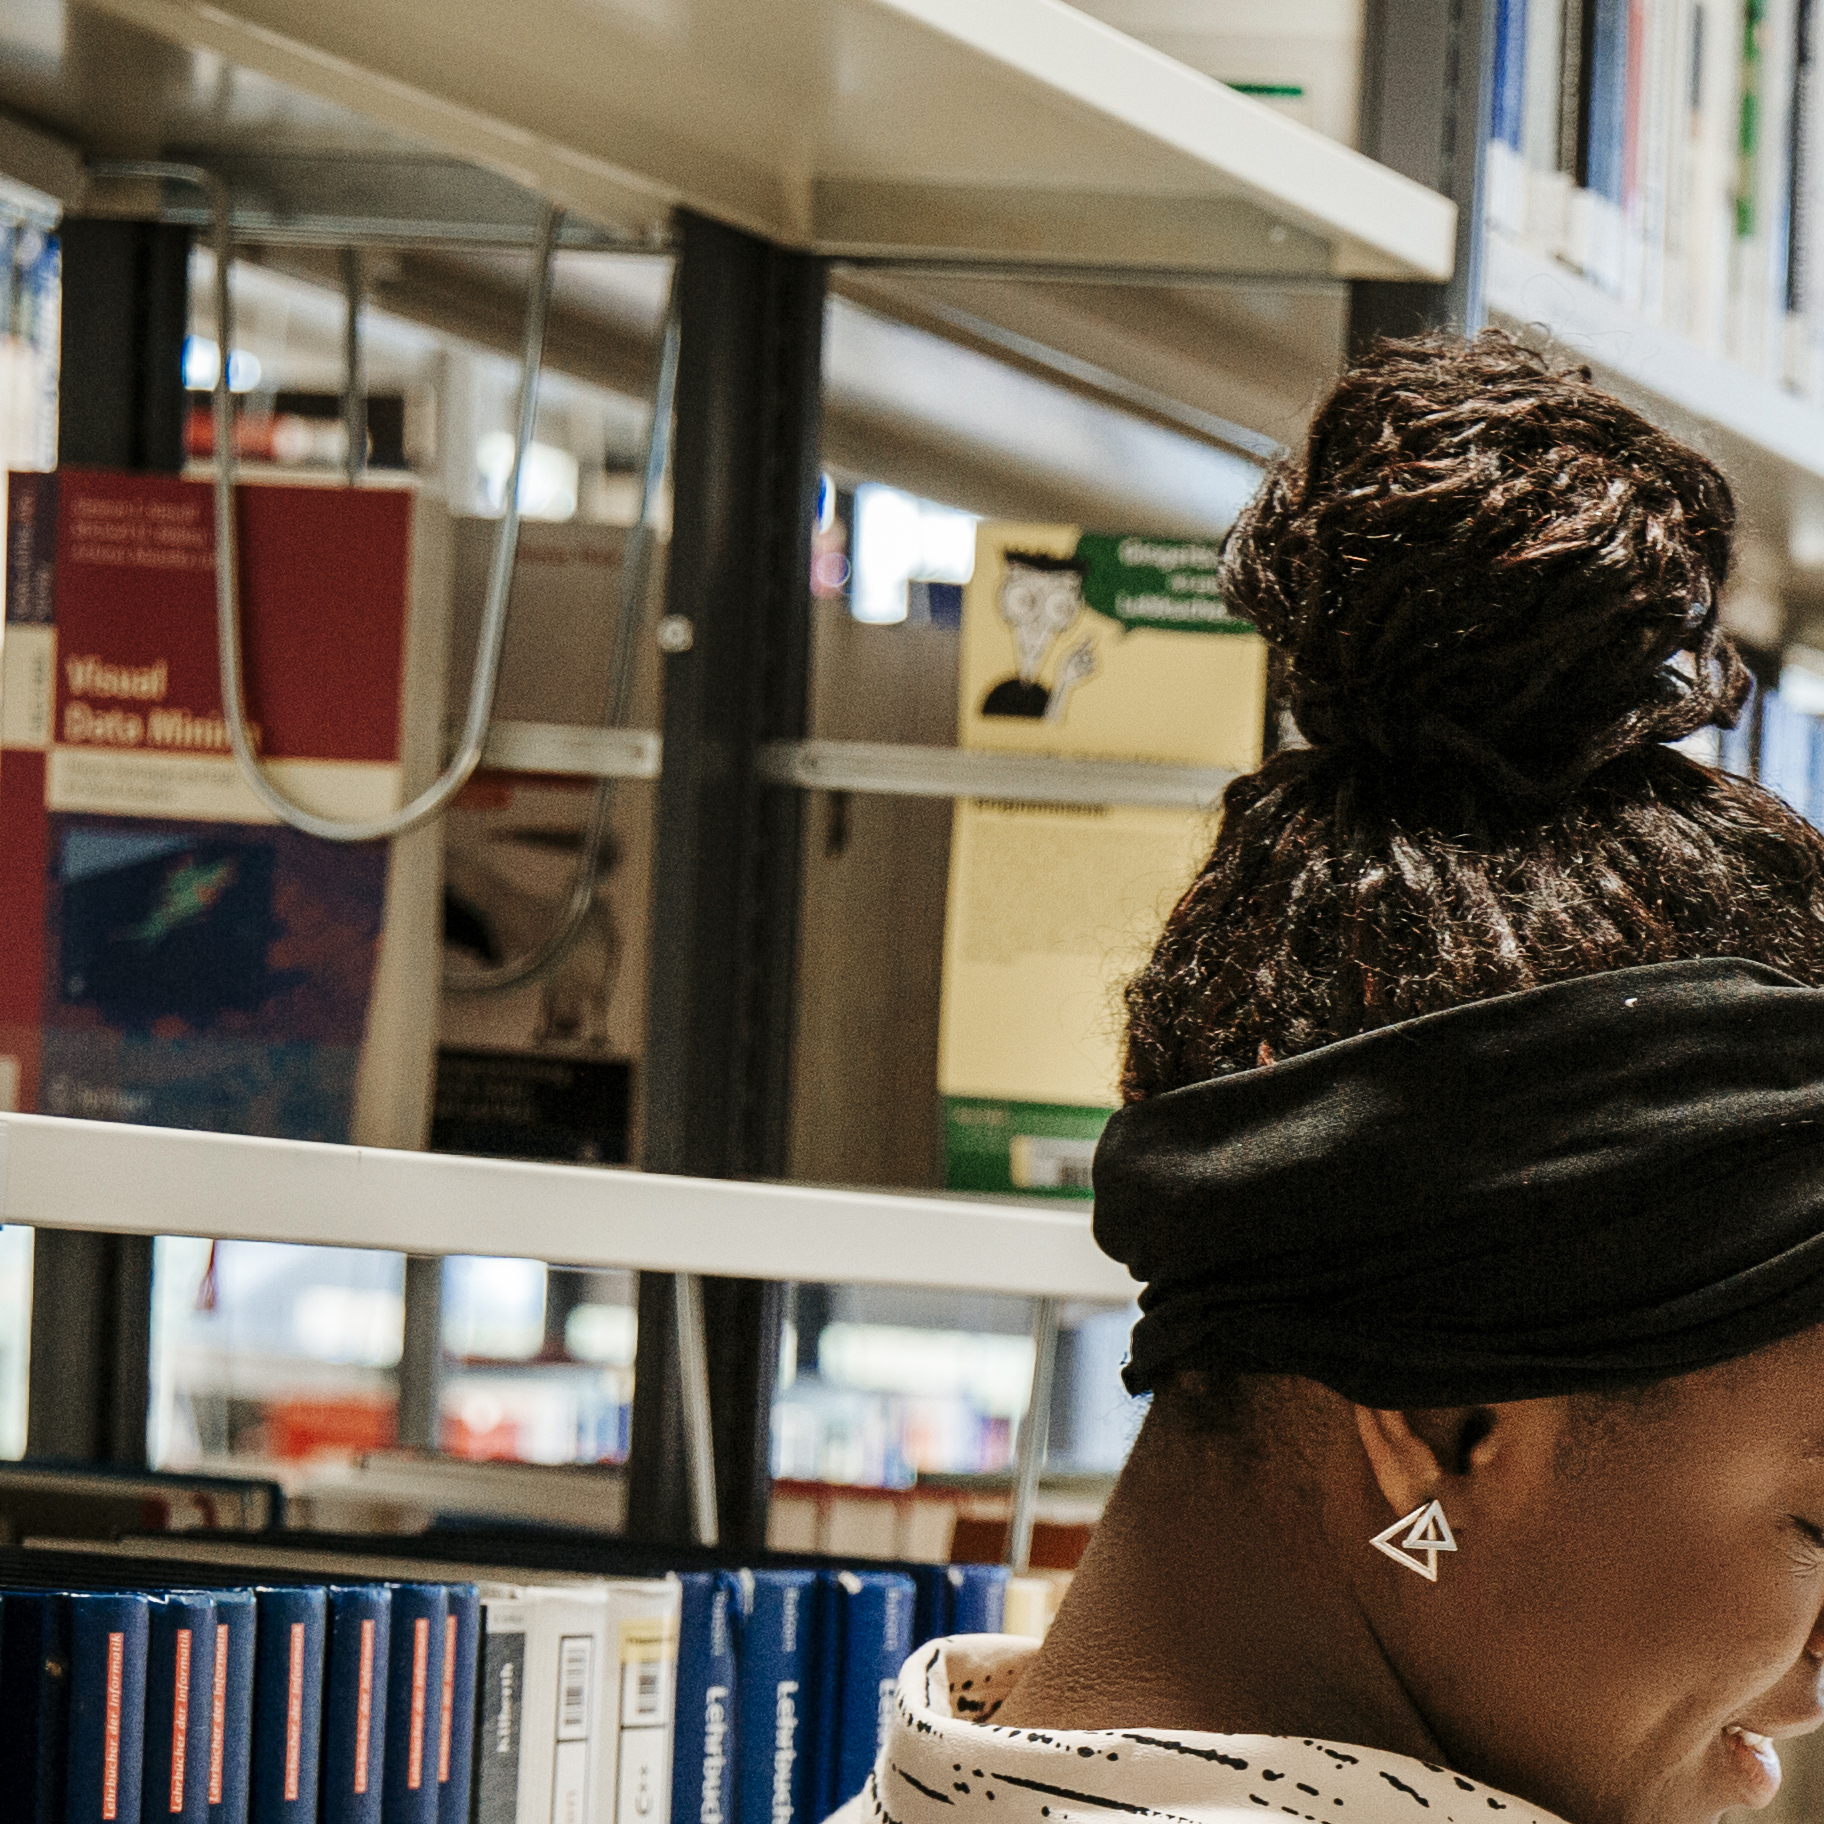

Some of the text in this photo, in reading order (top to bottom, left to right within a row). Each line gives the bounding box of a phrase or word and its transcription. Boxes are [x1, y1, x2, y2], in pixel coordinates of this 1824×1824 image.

[65, 655, 168, 699] Visual
[63, 702, 146, 745] Data
[105, 1634, 122, 1817] Lehrbücher der Informatik
[172, 1632, 191, 1811] Lehrbücher der Informatik
[213, 1702, 224, 1721] der
